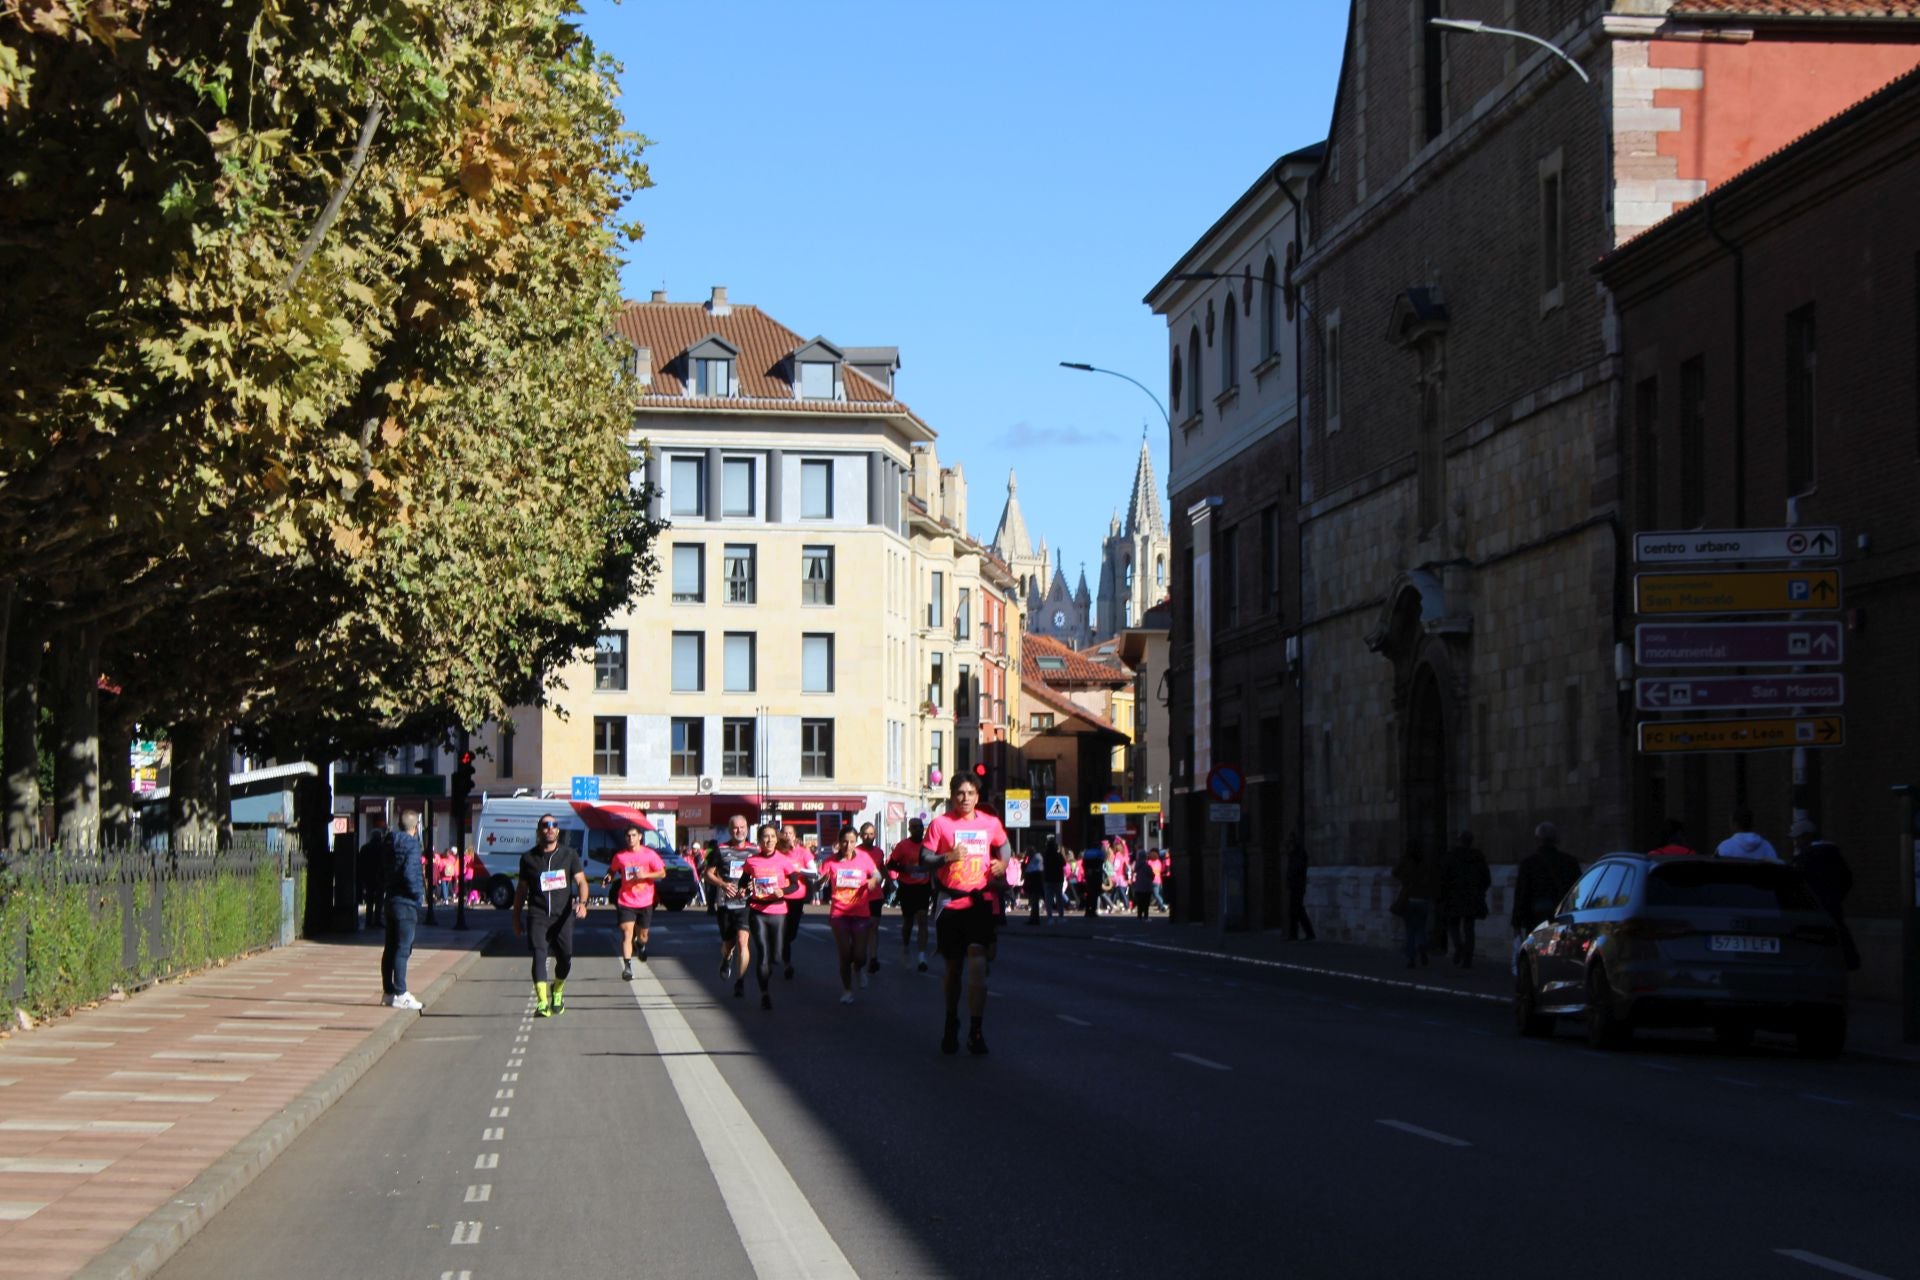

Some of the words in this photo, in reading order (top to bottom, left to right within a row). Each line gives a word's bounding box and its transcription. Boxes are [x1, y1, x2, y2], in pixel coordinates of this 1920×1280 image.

[1644, 541, 1685, 554] centro
[1695, 540, 1740, 553] urbano
[1645, 645, 1727, 658] monumental
[1752, 685, 1776, 698] San
[1786, 684, 1834, 697] Marcos
[1670, 730, 1724, 743] Inantes
[760, 801, 794, 811] BGER
[802, 801, 824, 811] KING
[499, 835, 514, 843] Cruz
[515, 835, 530, 844] Roja
